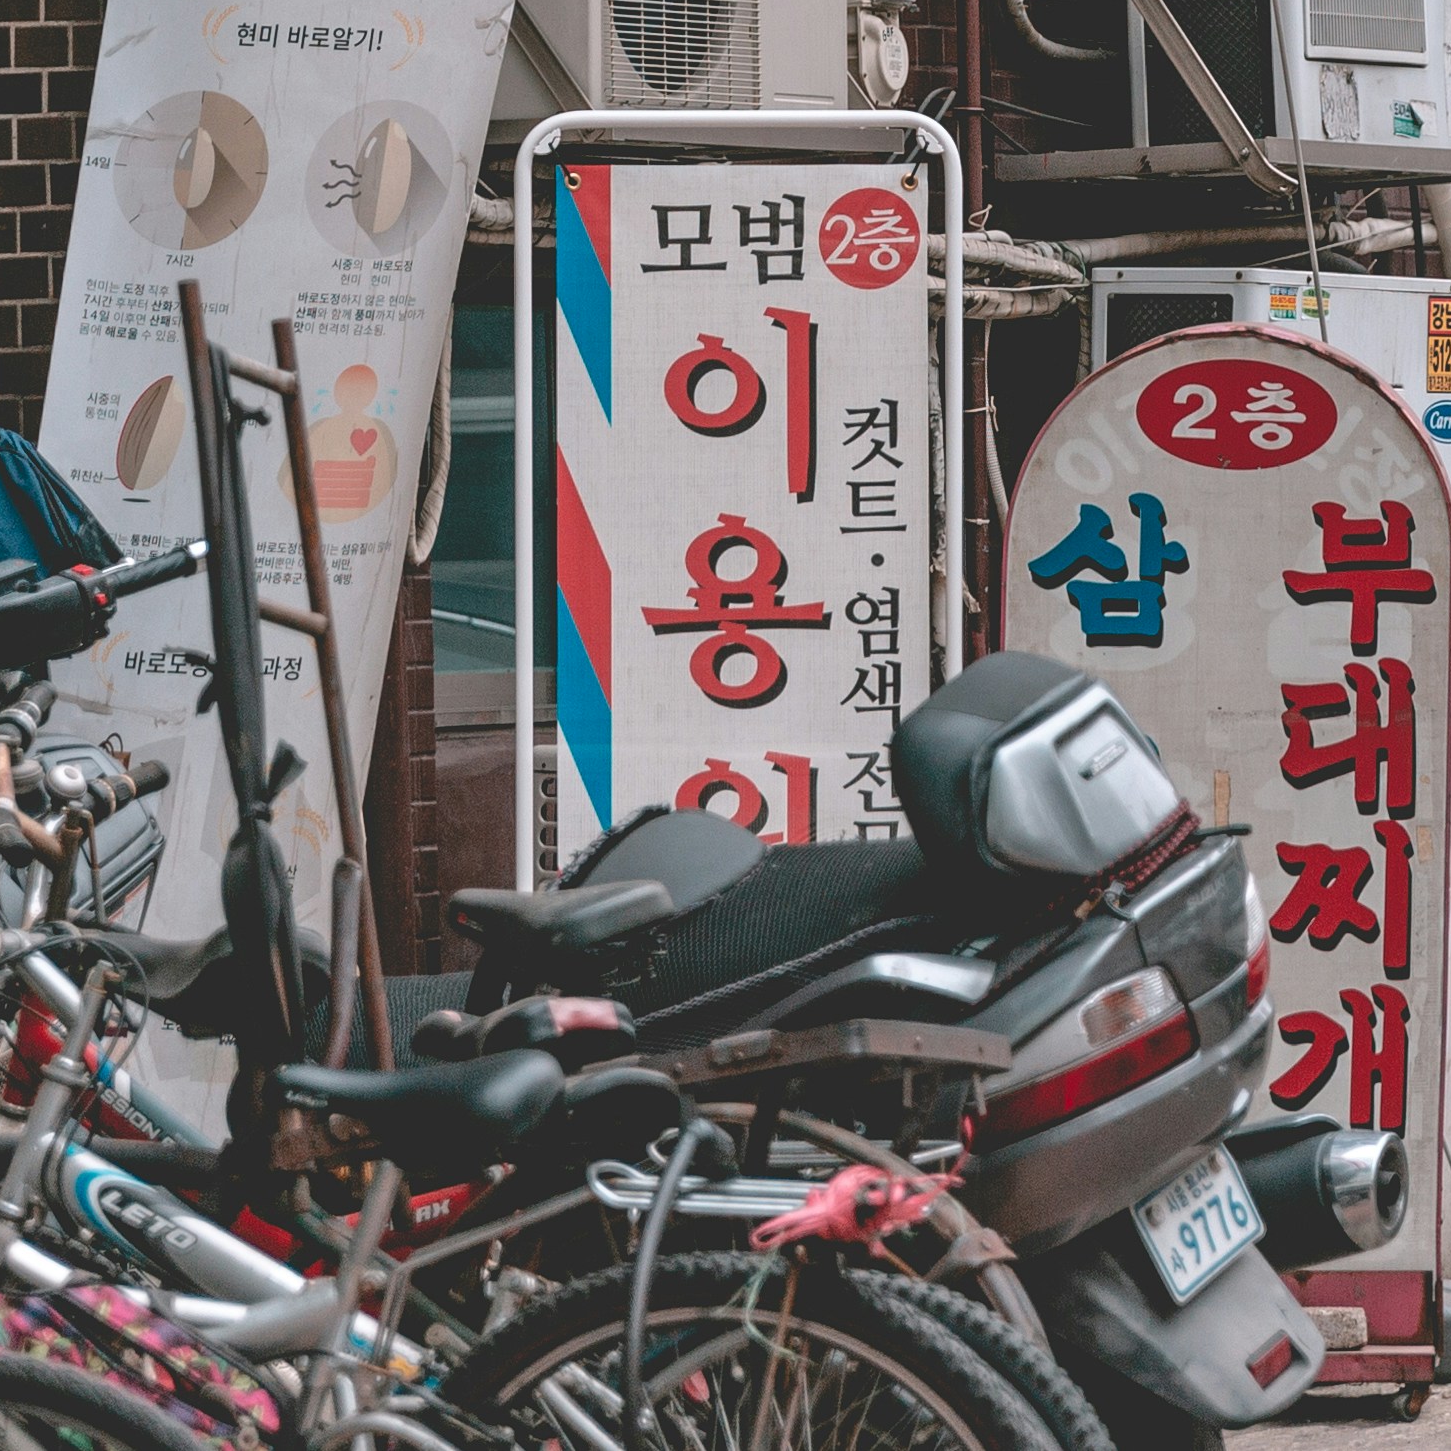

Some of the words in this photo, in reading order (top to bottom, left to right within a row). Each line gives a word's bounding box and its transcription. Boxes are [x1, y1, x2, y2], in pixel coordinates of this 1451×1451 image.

[237, 22, 280, 48] 현미
[287, 25, 384, 52] 바로알기!
[85, 155, 111, 170] 14일
[640, 193, 806, 286] 모범
[824, 208, 915, 272] 2층
[166, 254, 194, 267] 7시간
[372, 259, 413, 272] 바로도정
[83, 293, 113, 308] 7시간
[86, 278, 119, 294] 현미는
[122, 282, 145, 296] 도정
[81, 309, 110, 323] 14일
[104, 325, 138, 340] 해로울
[86, 391, 121, 407] 시중의
[1170, 380, 1307, 450] 2층
[1026, 492, 1191, 649] 삼
[262, 655, 303, 682] 과정
[1268, 500, 1438, 1140] 부대찌개
[98, 1189, 200, 1252] LETO
[1178, 1184, 1249, 1265] 9776
